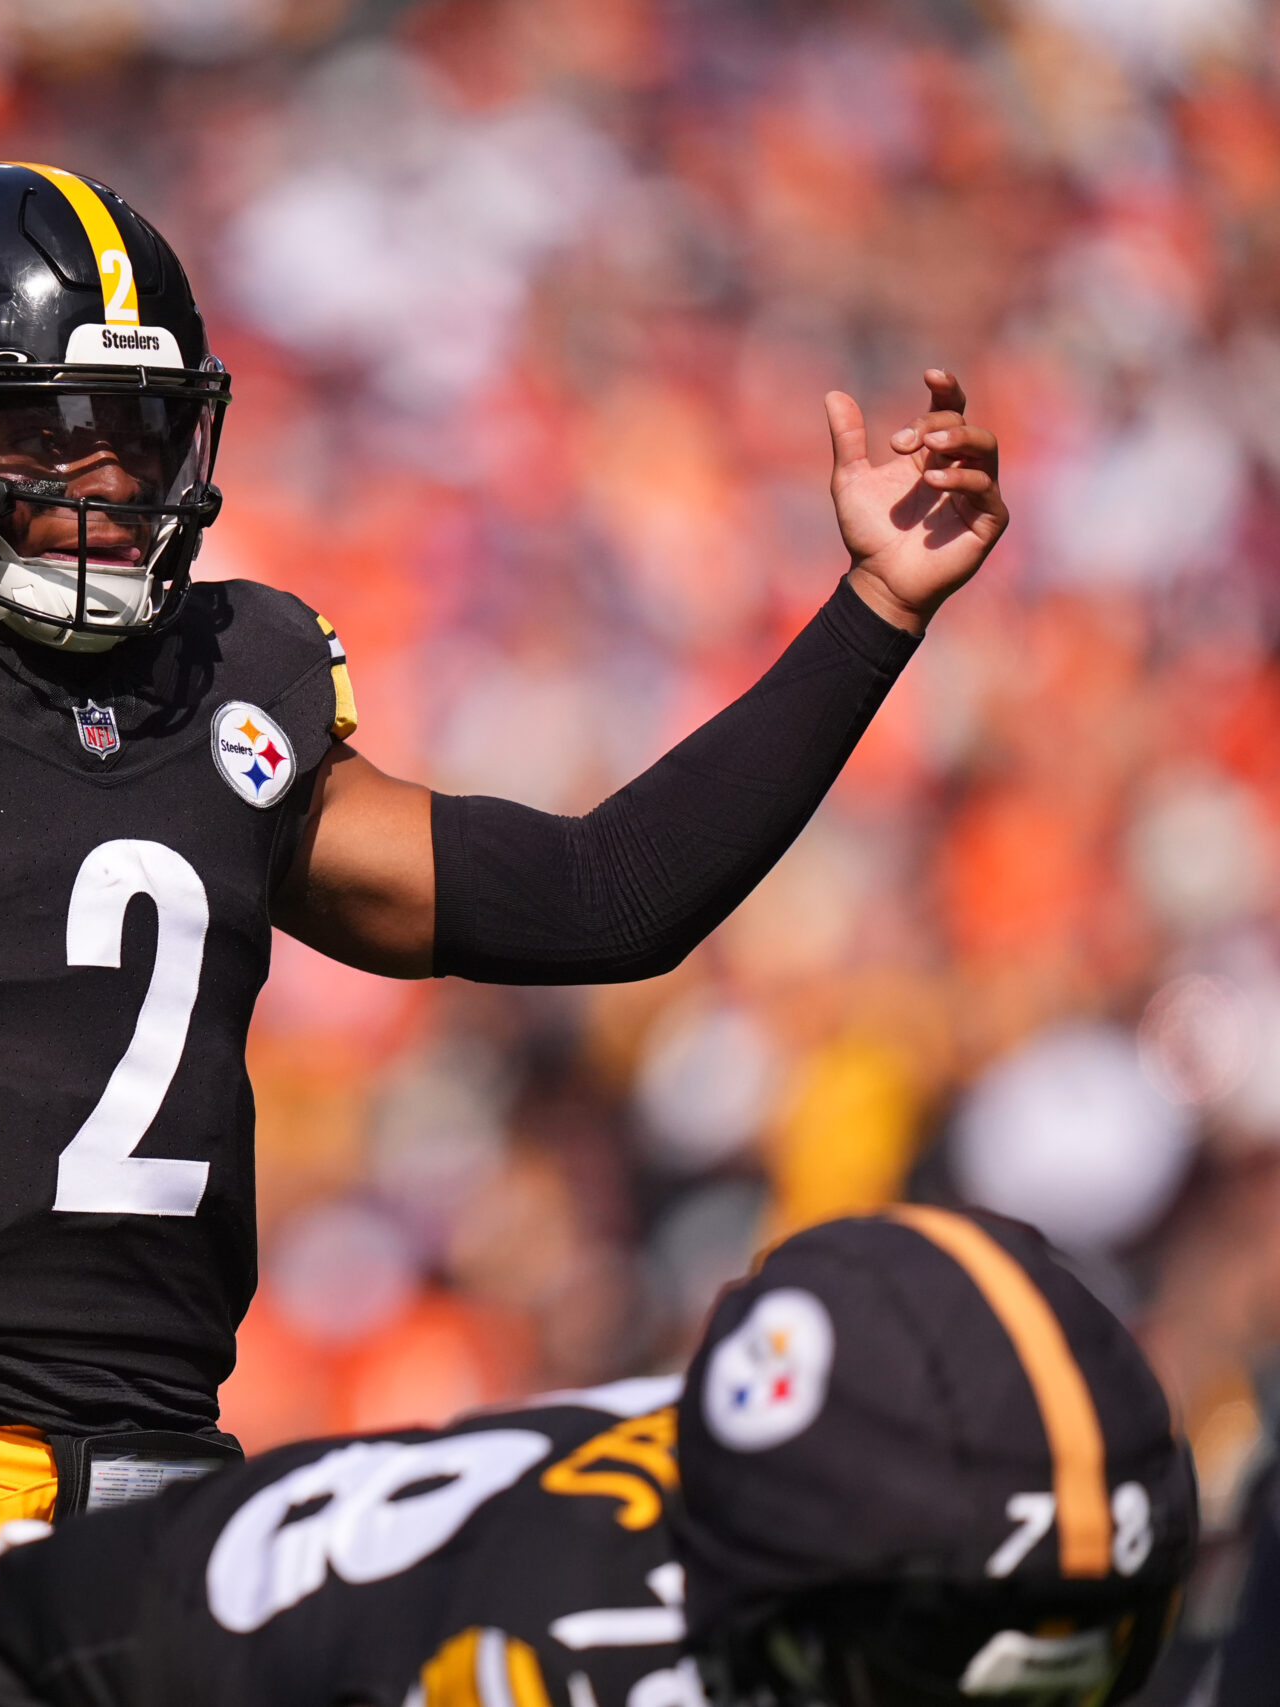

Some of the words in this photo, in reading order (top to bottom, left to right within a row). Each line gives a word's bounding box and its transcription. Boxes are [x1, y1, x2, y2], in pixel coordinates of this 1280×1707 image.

[100, 249, 137, 321] 2
[102, 329, 160, 350] Steelers
[85, 726, 115, 747] NFL
[221, 739, 253, 756] Steelers
[52, 838, 210, 1216] 2
